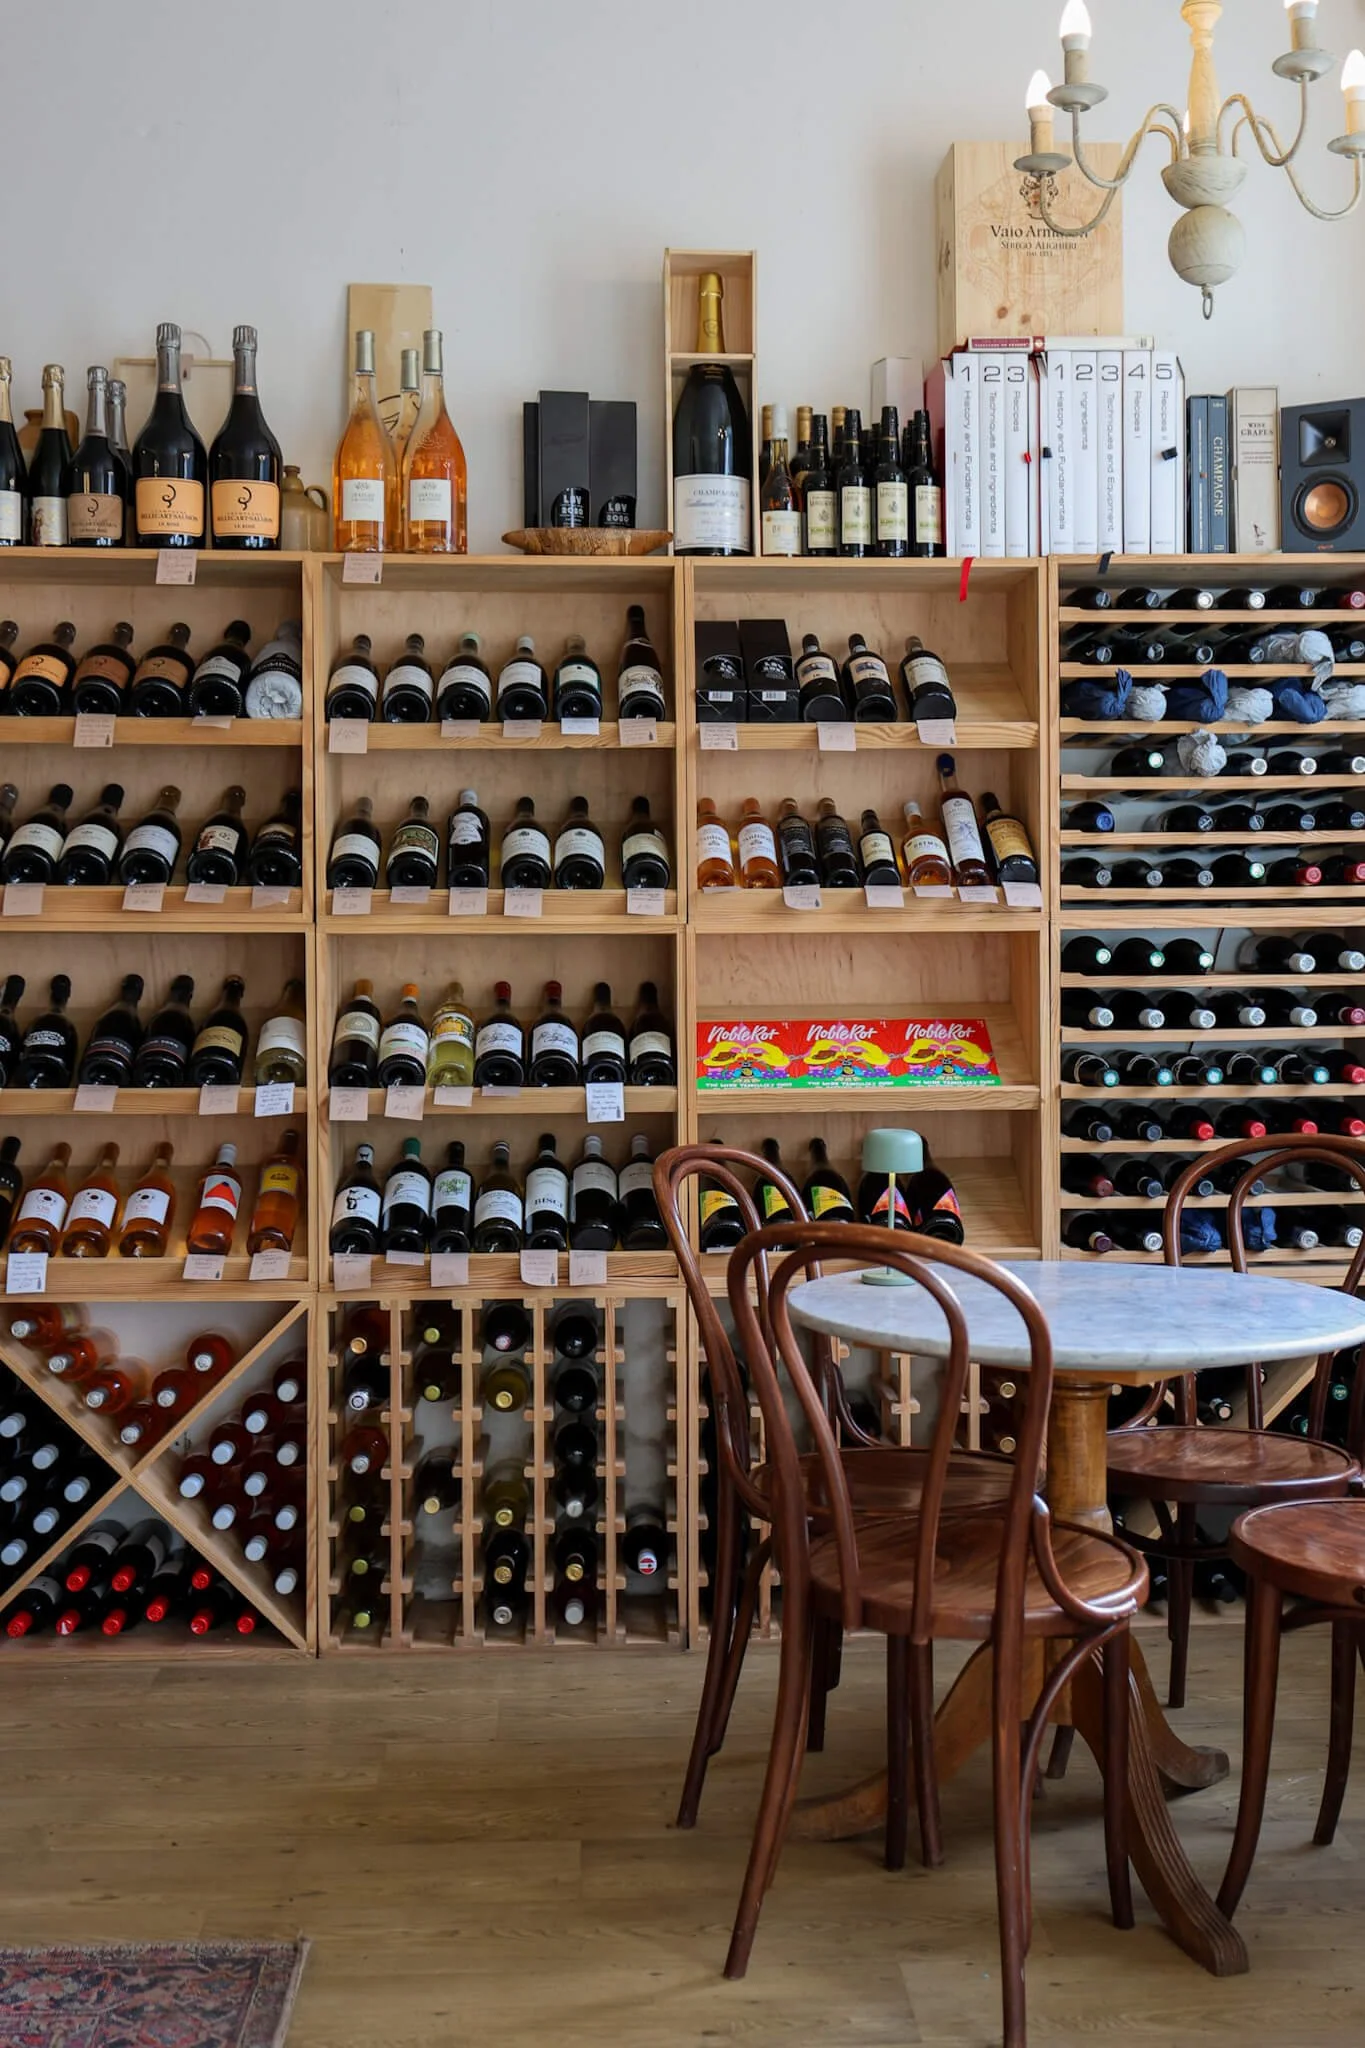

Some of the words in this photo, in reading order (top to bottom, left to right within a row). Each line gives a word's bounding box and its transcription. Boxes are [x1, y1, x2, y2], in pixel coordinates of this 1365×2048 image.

[991, 225, 1023, 238] Vaio
[961, 365, 970, 382] 1
[983, 365, 1001, 382] 2
[1007, 366, 1025, 382] 3
[1054, 363, 1064, 380] 1
[1075, 363, 1093, 381] 2
[1101, 365, 1119, 381] 3
[1128, 363, 1146, 379] 4
[1155, 363, 1173, 380] 5
[963, 390, 972, 430] History
[989, 391, 997, 449] Techniques
[1012, 390, 1021, 432] Recipes
[1056, 390, 1064, 431] History
[1080, 391, 1088, 451] Ingredients
[1106, 392, 1115, 450] Techniques
[1134, 390, 1142, 432] Recipes
[1160, 390, 1169, 432] Recipes
[1057, 433, 1065, 453] and
[1240, 429, 1274, 437] GRAPES
[964, 456, 972, 530] Fundamentals
[1057, 455, 1066, 530] Fundamentals
[1213, 436, 1224, 517] CHAMPAGNE
[608, 502, 628, 513] LBV
[988, 475, 997, 534] Ingredients
[1106, 476, 1115, 533] Equipment
